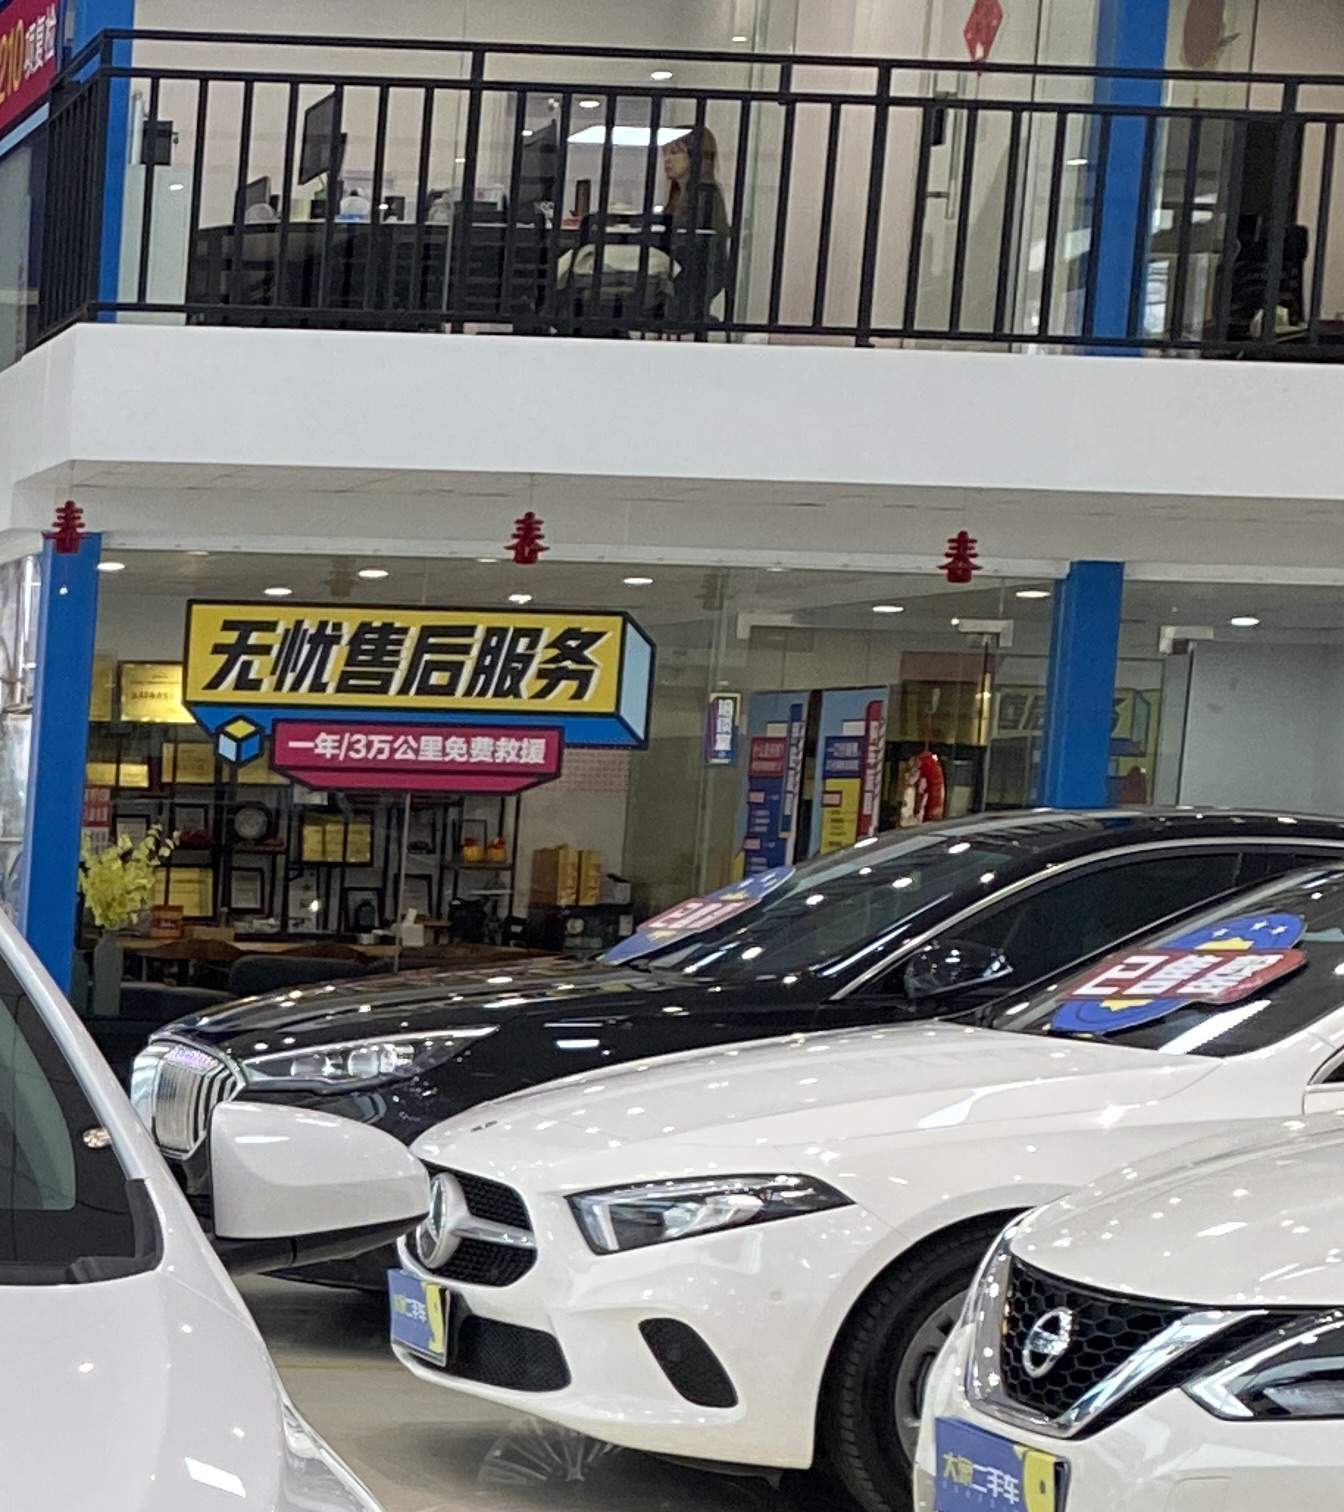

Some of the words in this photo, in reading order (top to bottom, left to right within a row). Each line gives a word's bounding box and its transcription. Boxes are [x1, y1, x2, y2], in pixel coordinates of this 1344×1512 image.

[202, 617, 613, 702] 无忧售后服务
[287, 731, 548, 766] 一年/3万公里免费救援
